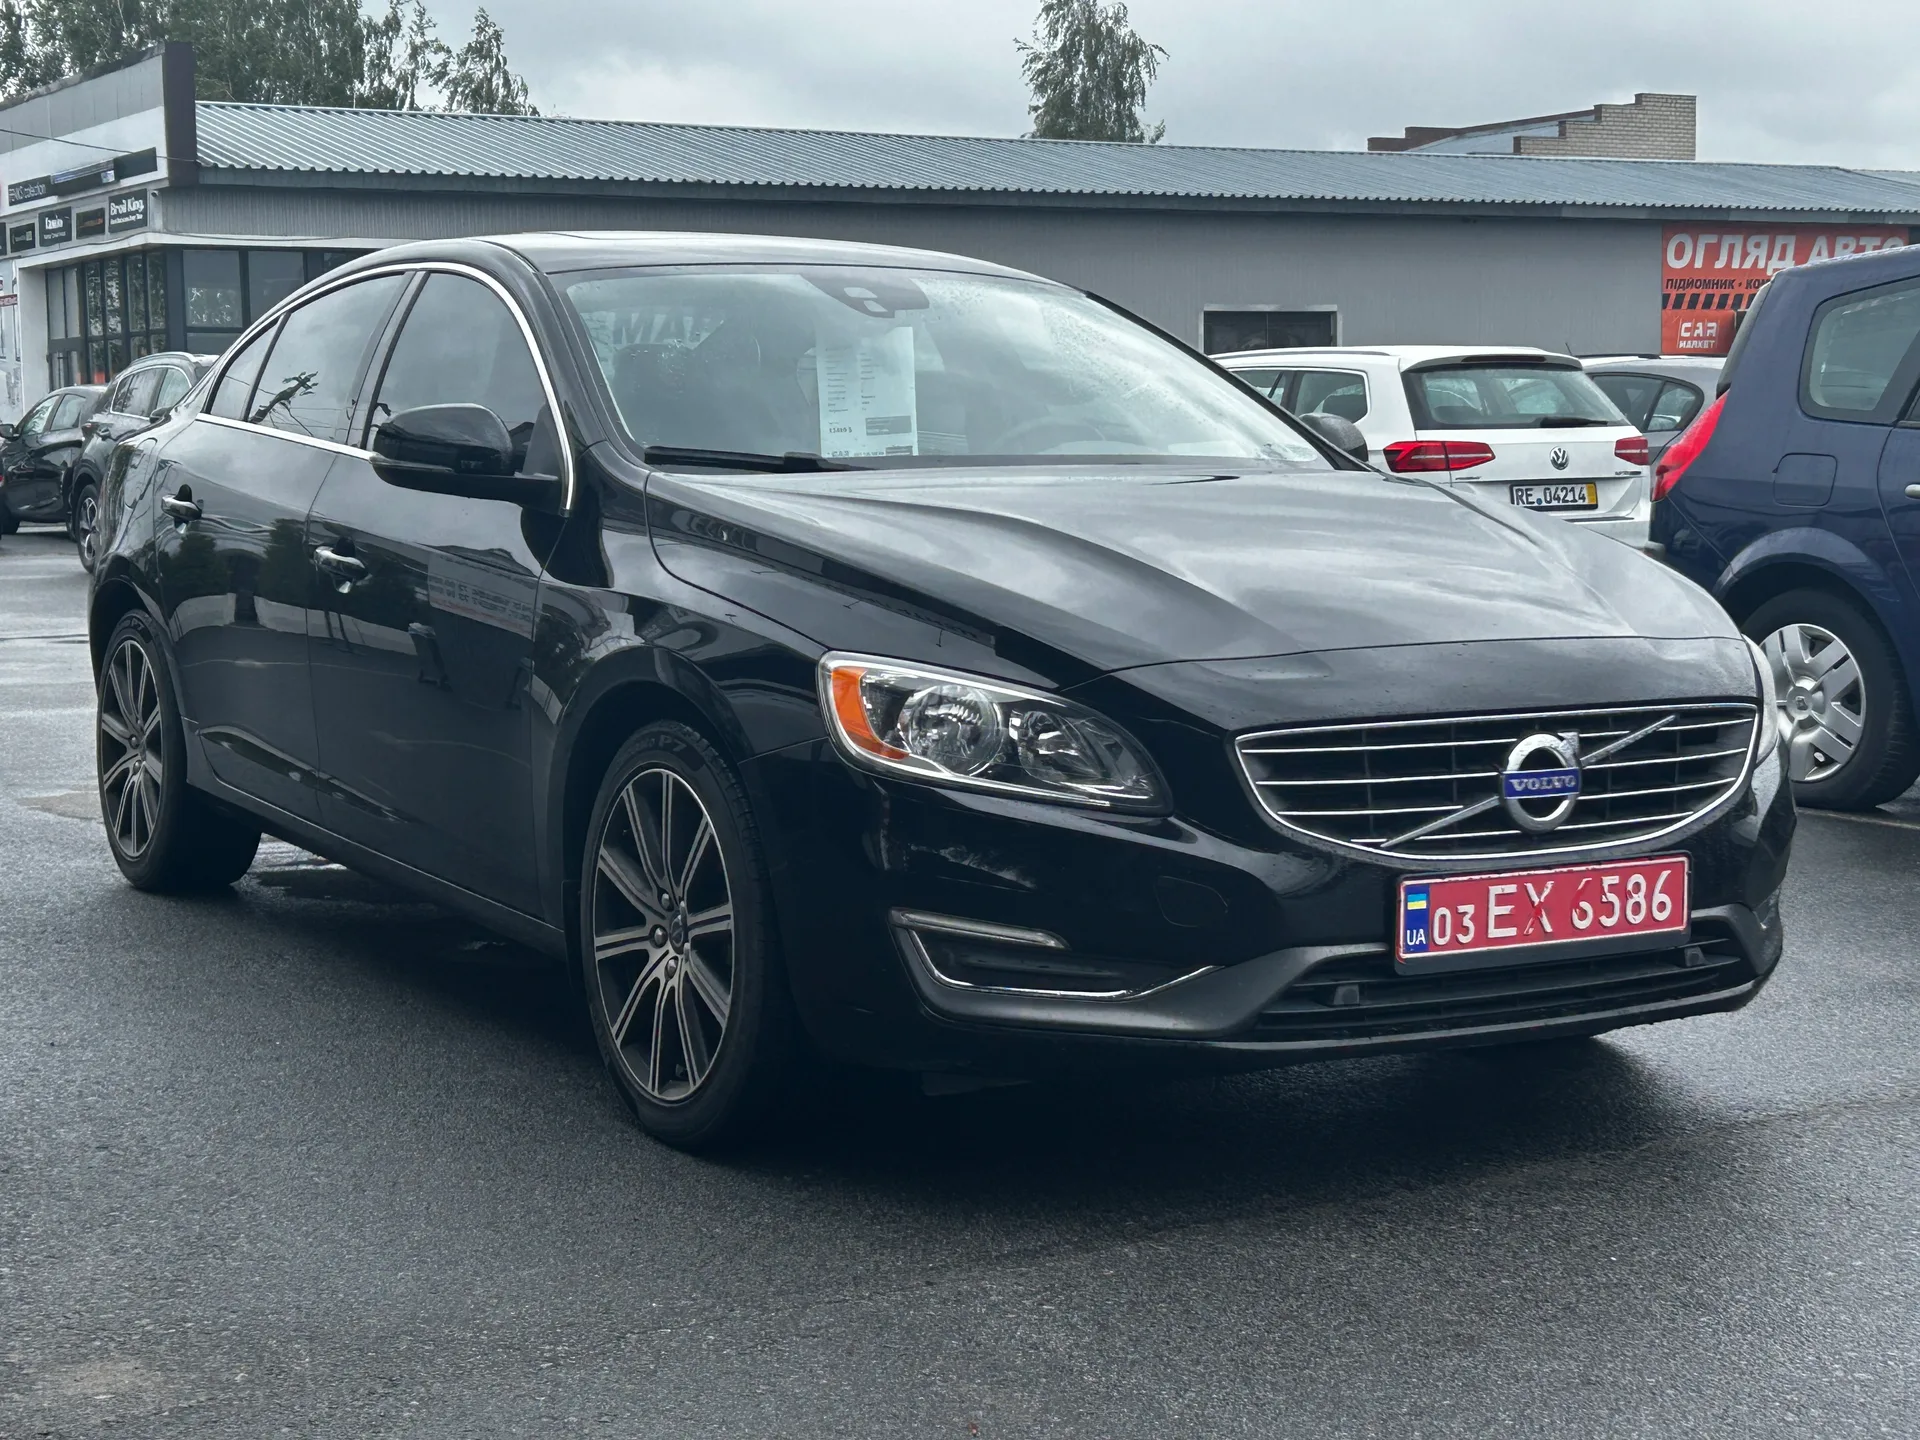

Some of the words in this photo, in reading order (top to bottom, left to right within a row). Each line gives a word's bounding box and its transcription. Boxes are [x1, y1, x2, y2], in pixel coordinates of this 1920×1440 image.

[1667, 233, 1796, 276] ОГЛЯД
[1665, 278, 1735, 291] ПІДЙОМНИК
[1681, 322, 1717, 337] CAR
[1679, 340, 1715, 349] MARKET
[1515, 487, 1536, 505] RE
[1543, 486, 1586, 504] 04214
[1509, 775, 1576, 792] VOLVO
[1433, 904, 1476, 945] 03
[1571, 870, 1673, 929] 6586
[1406, 928, 1427, 945] UA
